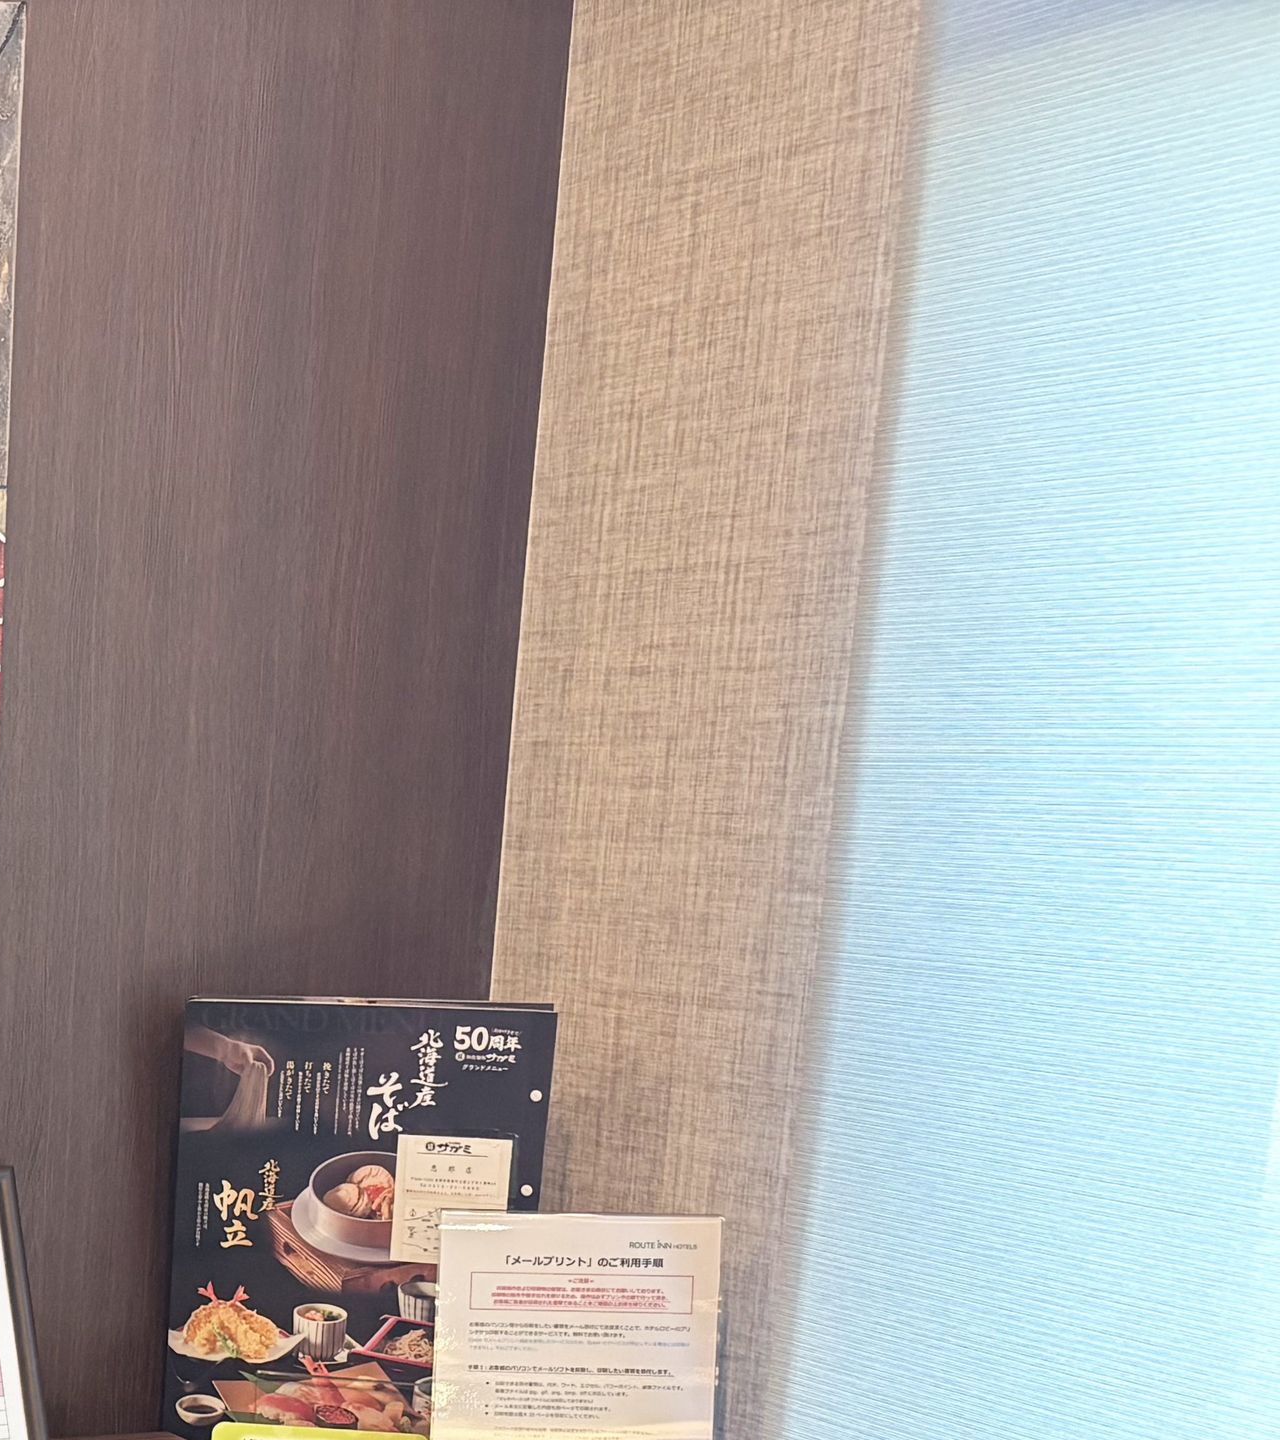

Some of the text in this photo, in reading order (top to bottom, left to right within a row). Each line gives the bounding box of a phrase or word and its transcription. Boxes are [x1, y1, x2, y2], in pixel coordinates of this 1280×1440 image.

[453, 1025, 523, 1052] 50周年
[410, 1028, 448, 1108] 北海道産
[366, 1072, 410, 1141] そば
[437, 1142, 473, 1154] サガミ
[257, 1158, 284, 1213] 北海道産
[212, 1179, 259, 1249] 帆立
[503, 1254, 664, 1269] 「メールプリント」のご利用手順
[629, 1241, 656, 1250] ROUTE
